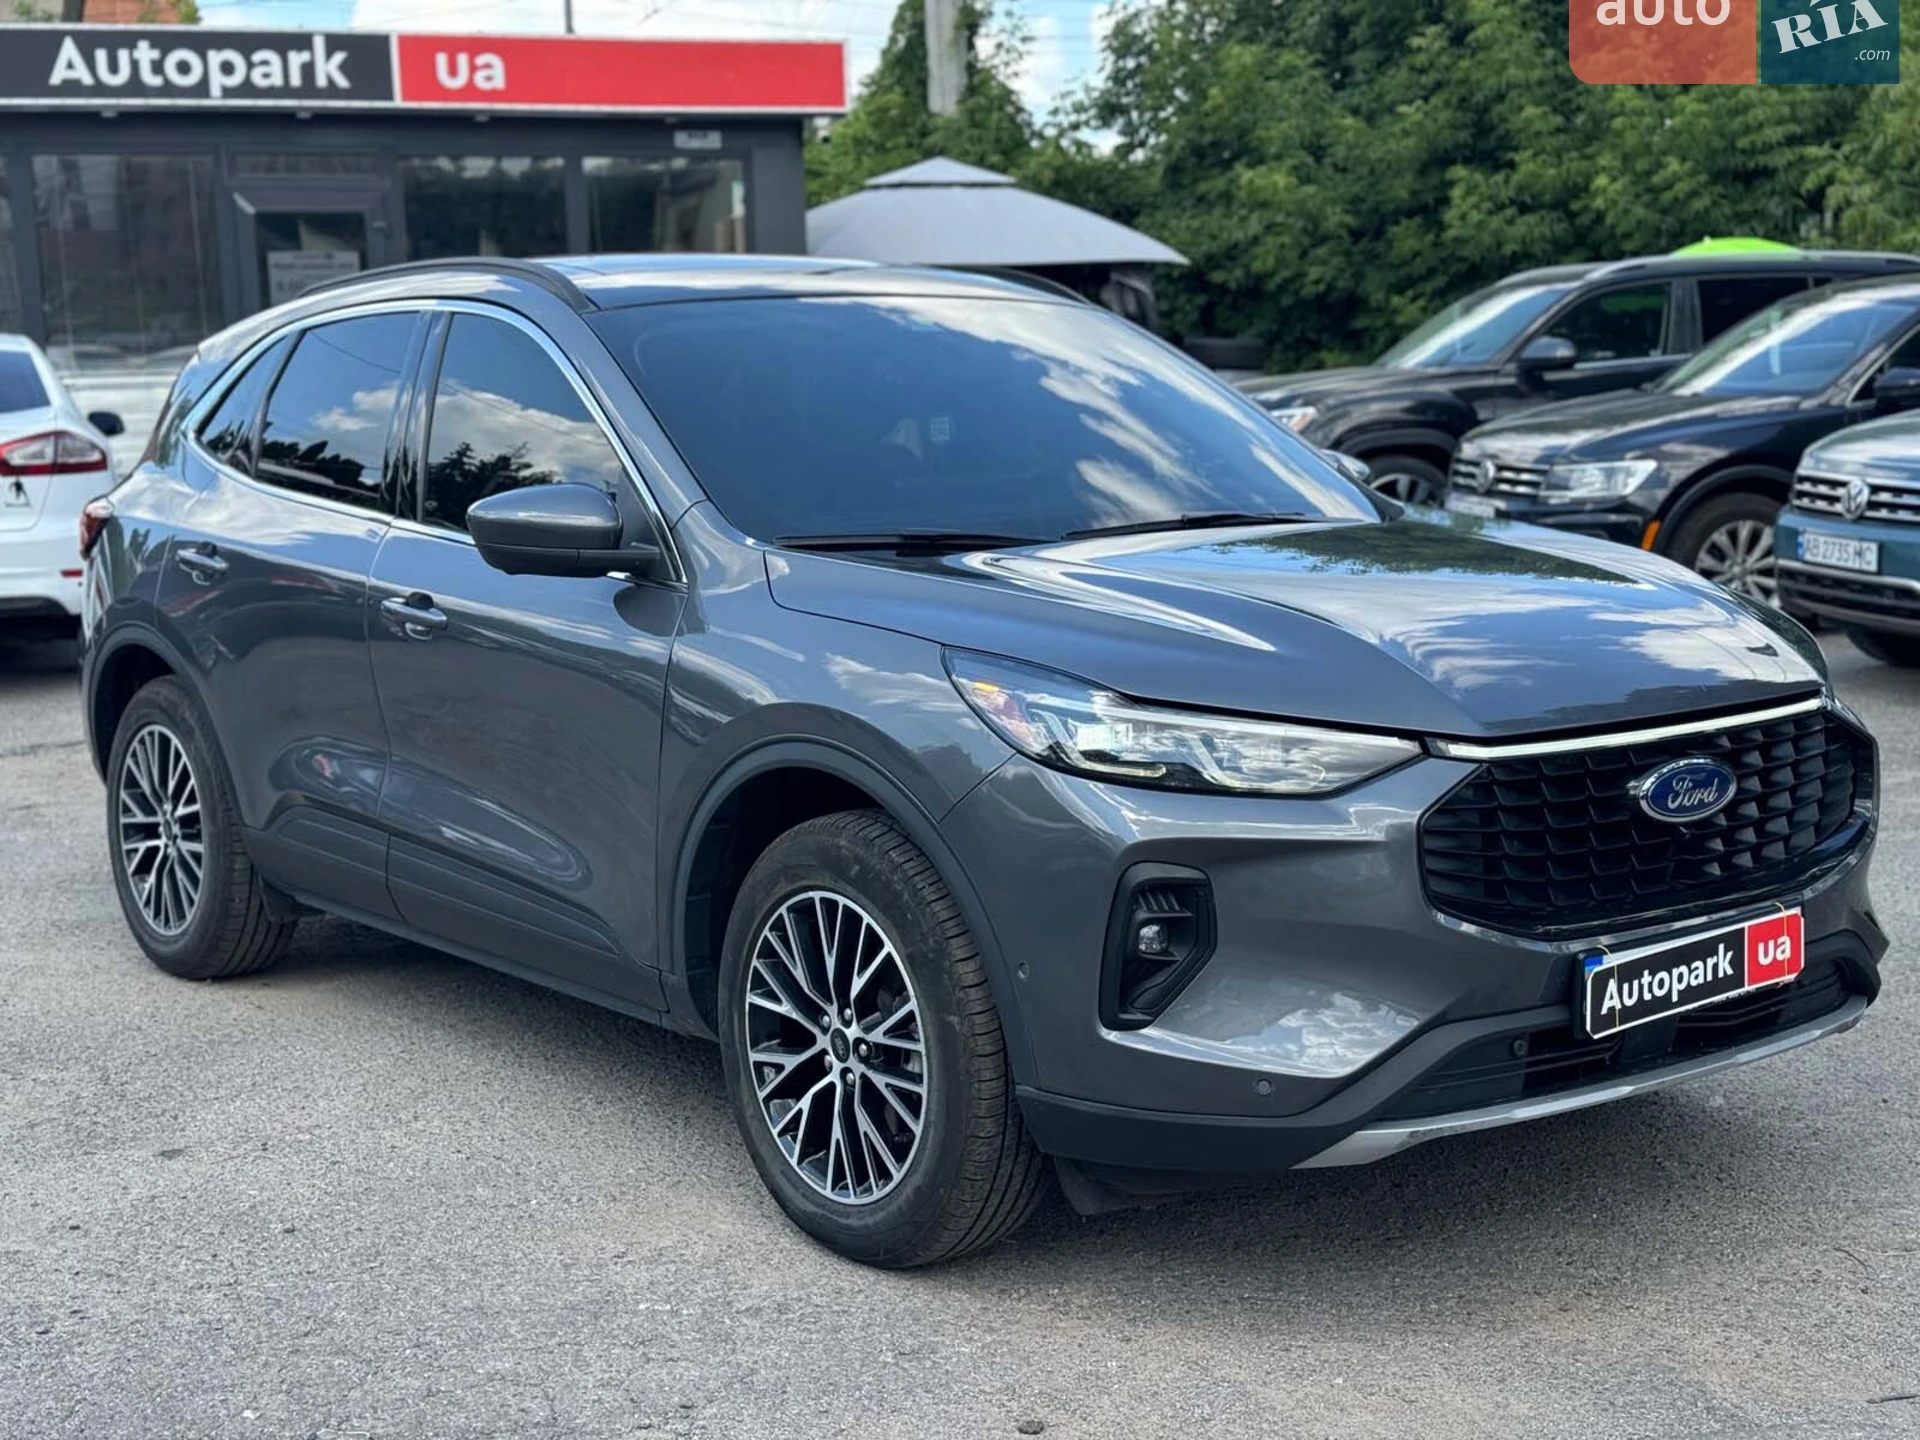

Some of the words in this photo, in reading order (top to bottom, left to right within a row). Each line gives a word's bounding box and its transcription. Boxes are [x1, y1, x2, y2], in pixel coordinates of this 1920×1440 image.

[48, 35, 352, 98] Autopark
[435, 51, 506, 91] ua
[1667, 772, 1719, 811] Ford
[1600, 943, 1734, 1015] Autopark
[1757, 934, 1792, 966] ua
